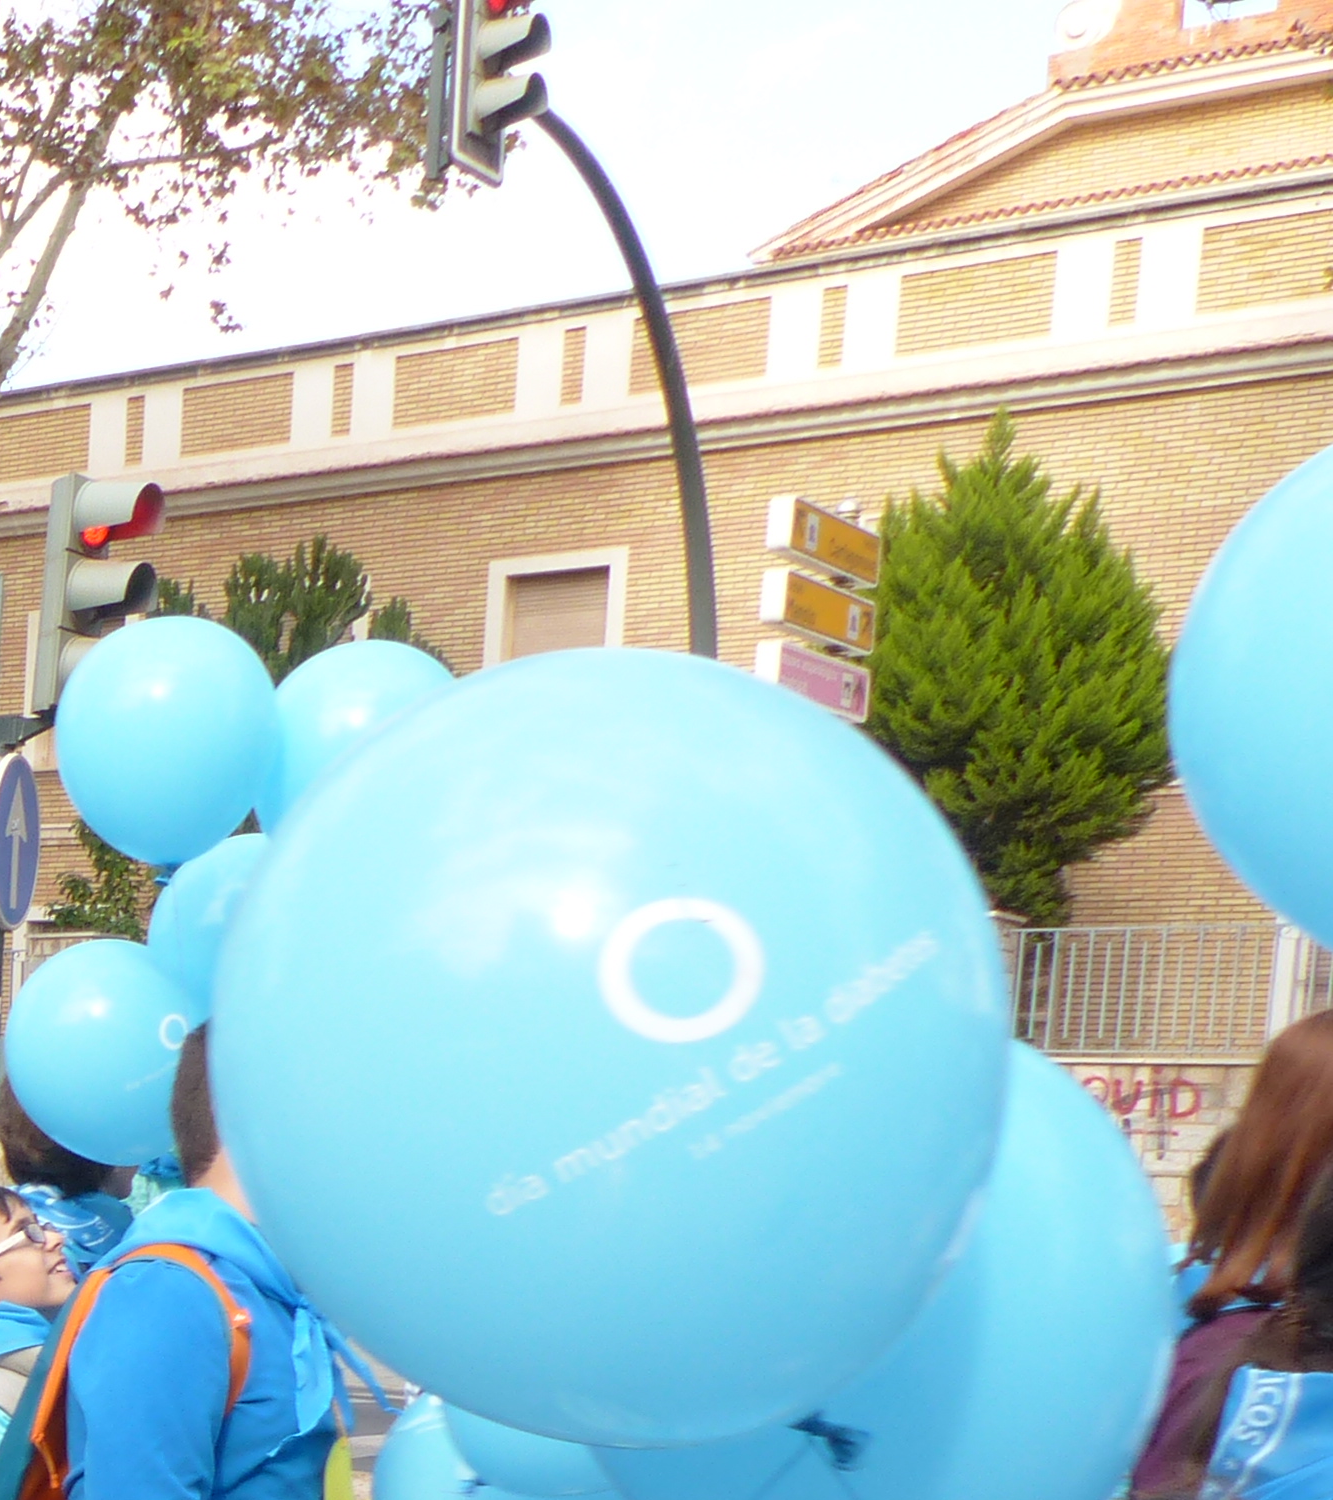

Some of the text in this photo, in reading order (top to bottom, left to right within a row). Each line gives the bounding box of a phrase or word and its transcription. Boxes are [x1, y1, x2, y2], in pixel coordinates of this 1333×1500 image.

[553, 1066, 728, 1184] mundial
[729, 1040, 783, 1083] de
[776, 1014, 827, 1051] la
